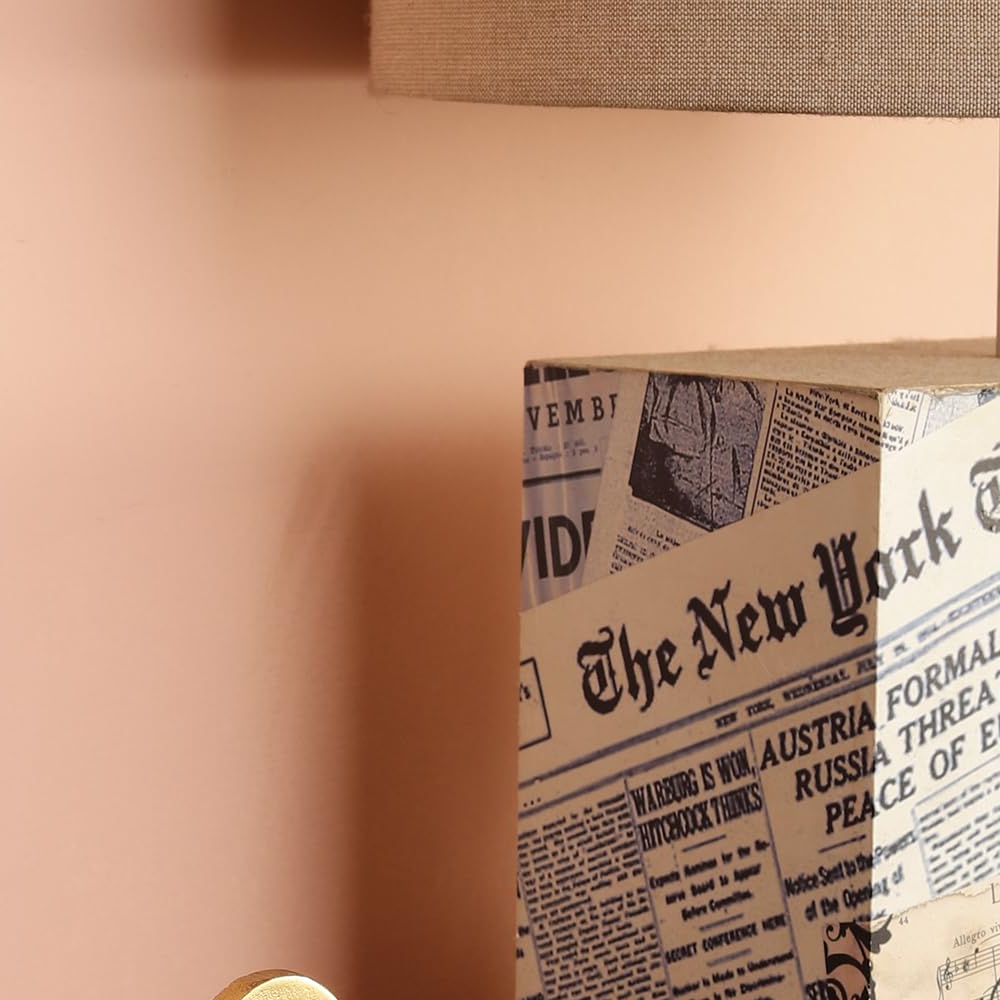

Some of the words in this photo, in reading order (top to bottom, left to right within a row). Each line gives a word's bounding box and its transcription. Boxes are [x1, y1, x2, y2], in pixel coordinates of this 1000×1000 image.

[577, 623, 683, 715] The
[687, 578, 807, 681] New
[813, 488, 962, 637] York
[760, 701, 877, 771] AUSTRIA
[699, 761, 716, 791] IS
[795, 740, 891, 803] RUSSIA
[825, 767, 916, 834] PEACE
[929, 734, 966, 780] OF
[952, 927, 987, 949] Allegro
